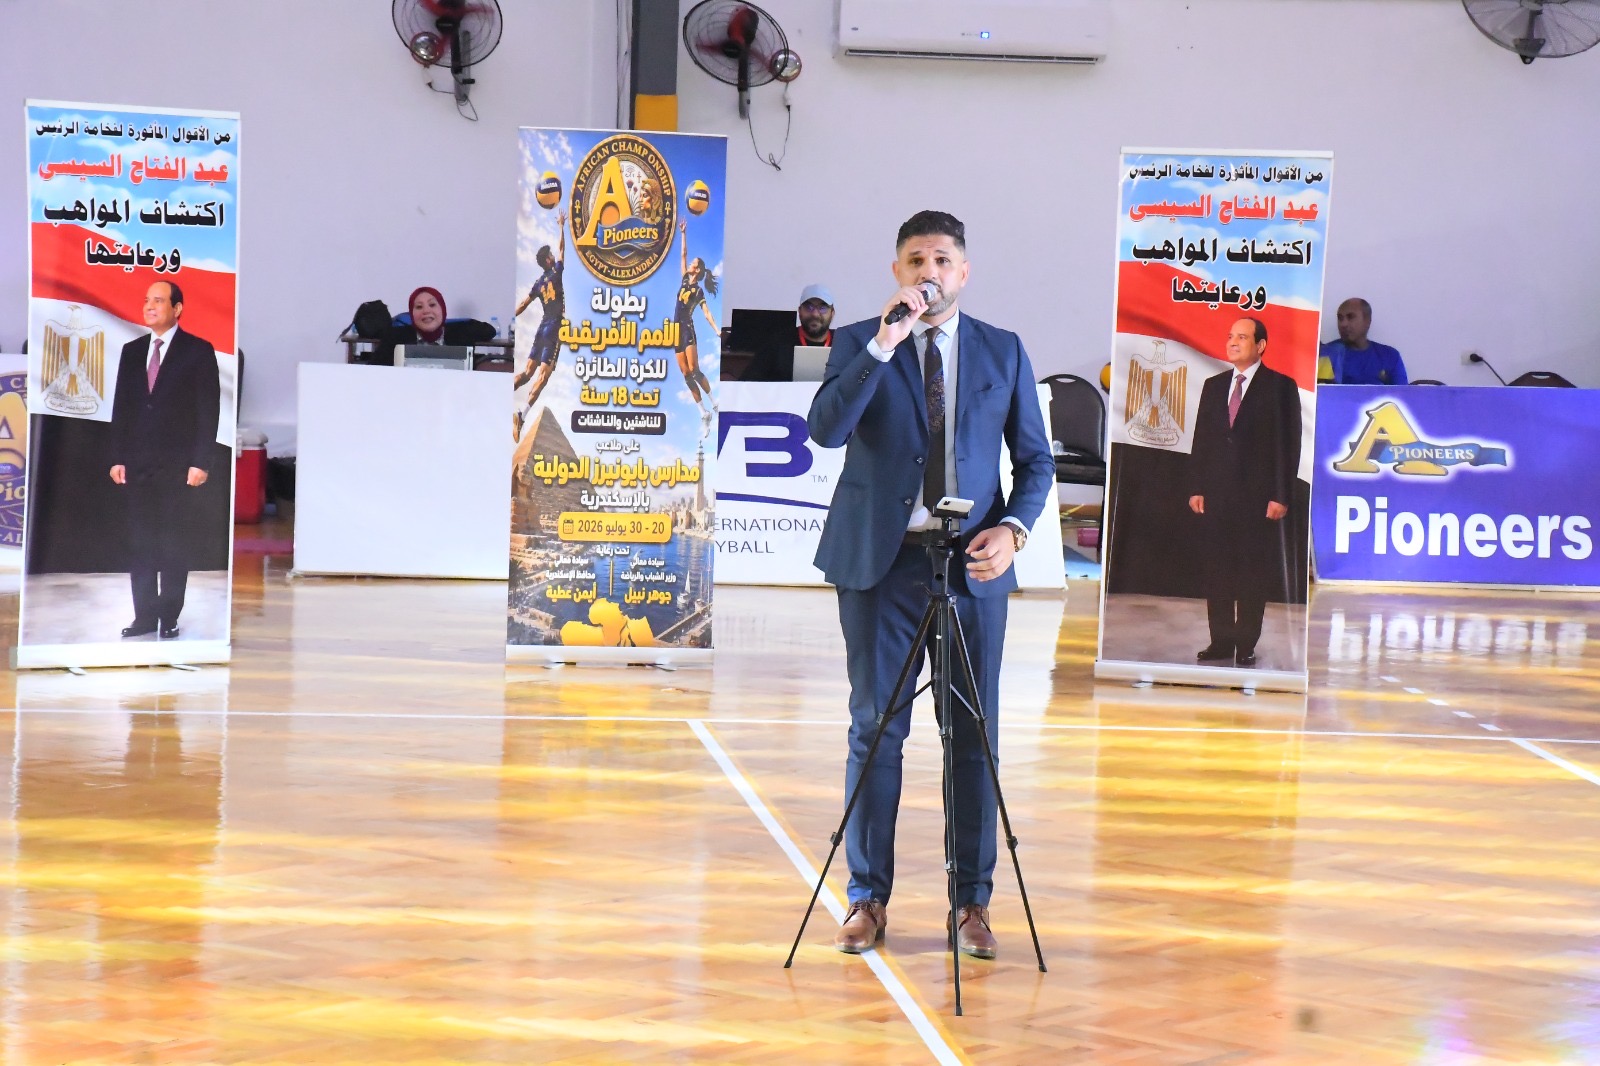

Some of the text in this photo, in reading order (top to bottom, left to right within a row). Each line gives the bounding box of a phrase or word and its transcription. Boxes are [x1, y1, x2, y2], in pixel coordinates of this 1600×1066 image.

[36, 119, 231, 146] من الأقوال المأثورة لفخامة الرئيس
[129, 155, 186, 185] الفتاح
[193, 161, 229, 186] عبد
[576, 145, 610, 193] AFRICAN
[1175, 164, 1215, 178] لفخامة
[1262, 165, 1301, 183] الأقوال
[1304, 169, 1323, 184] من
[44, 197, 224, 228] اكتشاف المواهب
[1218, 194, 1276, 225] الفتاح
[1283, 200, 1319, 226] عبد
[602, 226, 659, 246] Pioneers
[86, 239, 181, 273] ورعايتها
[1132, 236, 1312, 266] اكتشاف المواهب
[591, 287, 647, 319] بطولة
[1172, 276, 1267, 310] ورعايتها
[558, 316, 680, 353] الأمم الأفريقية
[575, 356, 667, 384] للكرة الطائرة
[580, 384, 660, 406] تحت 18 سنة
[577, 413, 661, 431] للناشئين والناشئات
[595, 438, 641, 454] على ملاعب
[1389, 445, 1475, 461] PIONEERS
[533, 454, 700, 488] مدارس بايونيرز الدولية
[811, 474, 828, 484] TM
[580, 488, 650, 513] بالإسكندرية
[577, 519, 603, 533] 2026
[605, 520, 627, 536] يوليو
[629, 520, 643, 534] 30
[651, 521, 665, 535] 20
[714, 517, 827, 532] ERNATIONA
[1335, 495, 1593, 560] Pioneers
[596, 545, 630, 556] تحت رعاية
[715, 540, 775, 554] YBALL
[545, 581, 597, 603] أيمن عطية
[624, 586, 672, 604] جوهر نبيل
